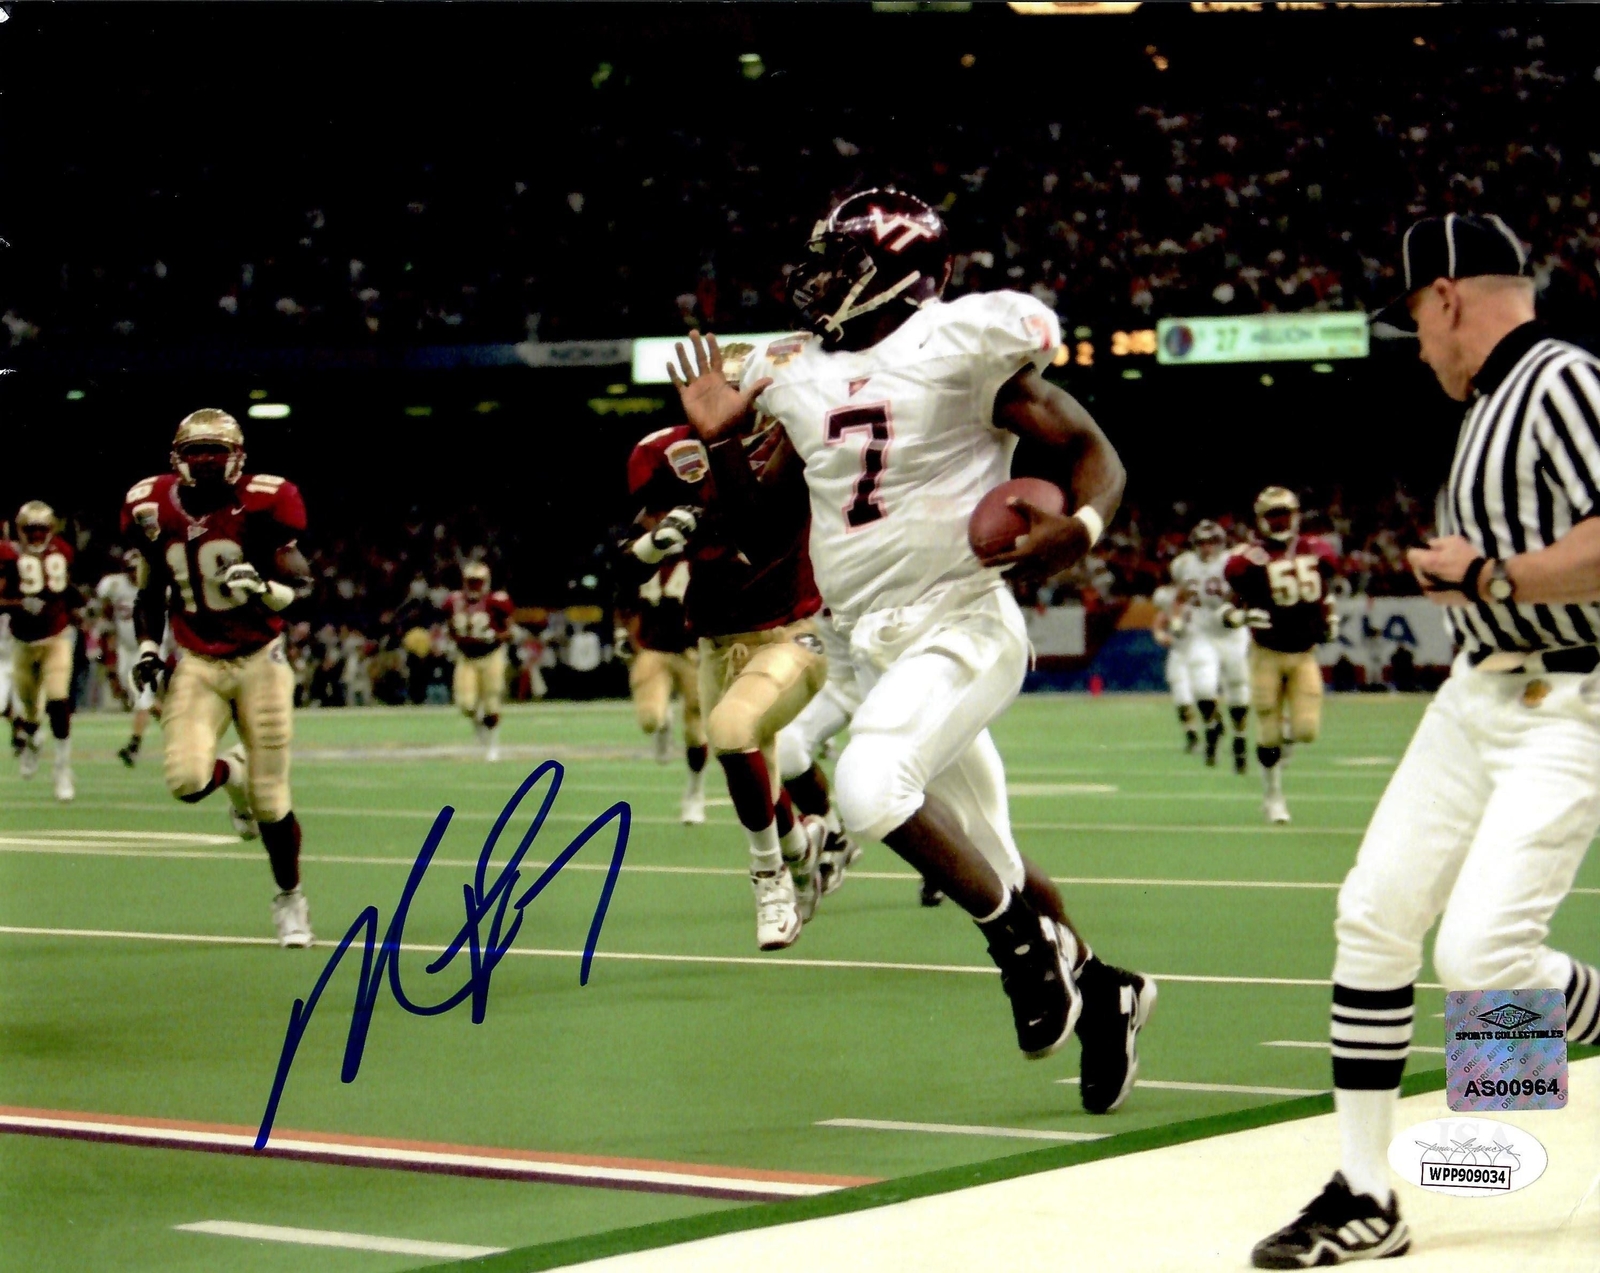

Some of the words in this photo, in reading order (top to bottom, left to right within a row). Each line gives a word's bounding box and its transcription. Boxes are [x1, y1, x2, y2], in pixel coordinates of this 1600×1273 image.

[868, 204, 938, 252] VT
[823, 400, 893, 534] 7
[16, 552, 68, 593] 99
[1266, 553, 1322, 607] 55
[1455, 1030, 1493, 1041] SPORTS
[1494, 1029, 1564, 1040] COLLECTIBLES
[1463, 1078, 1560, 1098] AS00964
[1429, 1166, 1506, 1184] WPP909034
